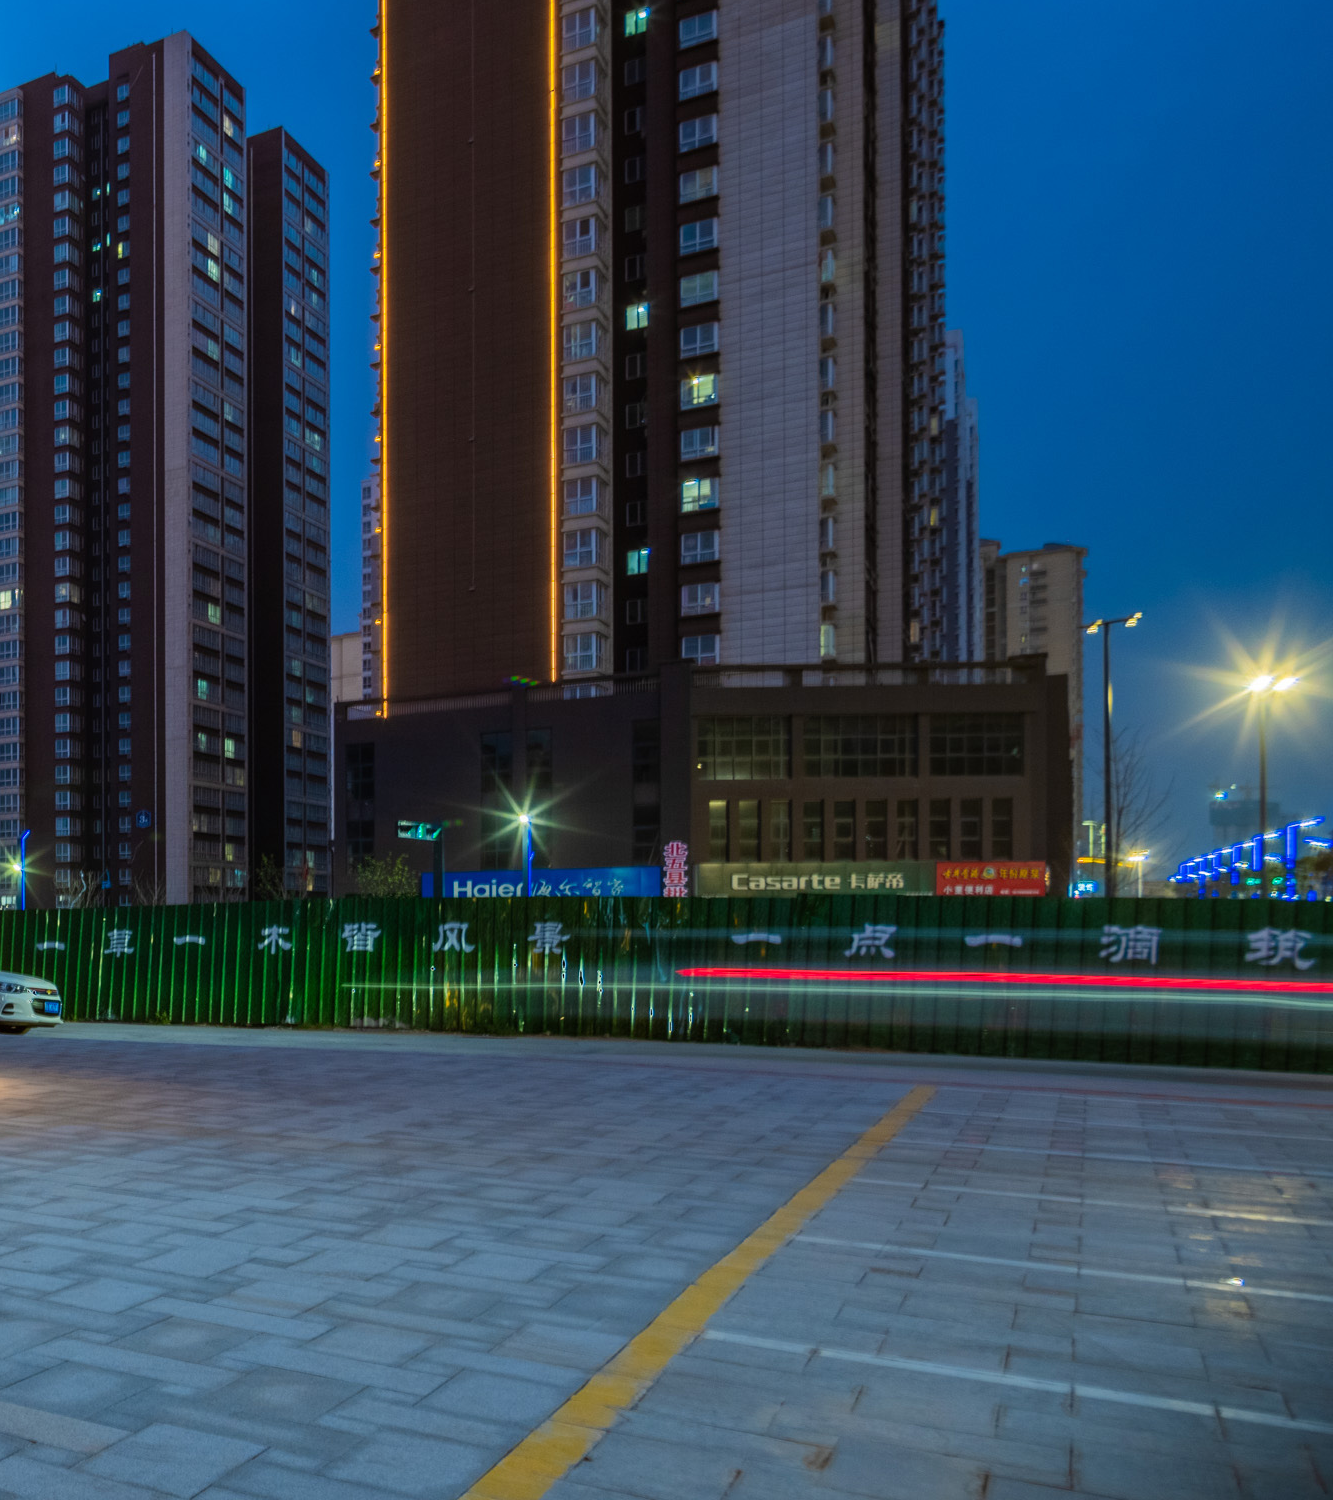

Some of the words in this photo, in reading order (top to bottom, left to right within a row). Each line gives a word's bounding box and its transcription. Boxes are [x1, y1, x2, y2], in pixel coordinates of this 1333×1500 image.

[452, 879, 525, 898] Haier
[731, 873, 841, 891] Casarte
[848, 871, 905, 890] 卡萨帝
